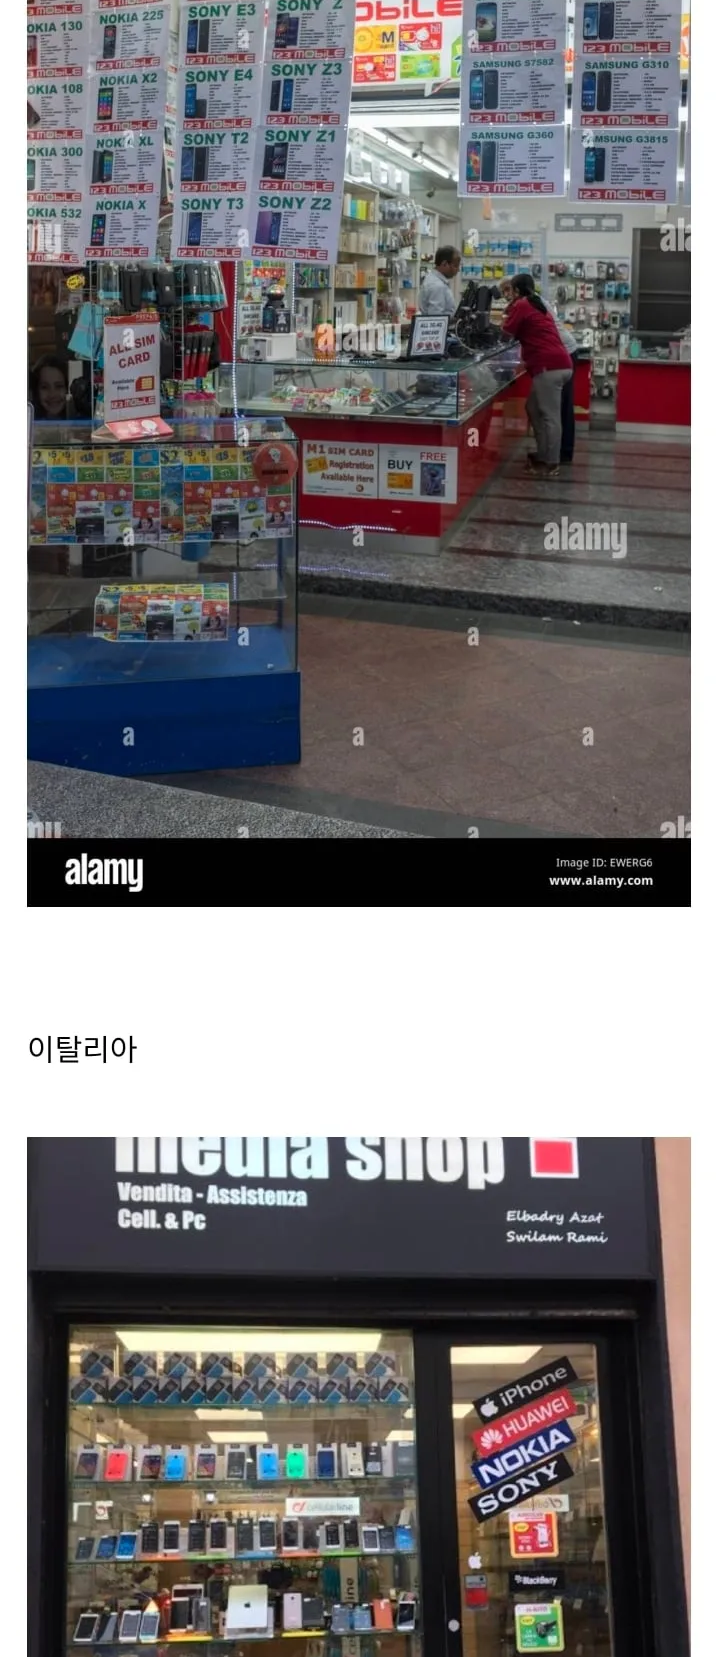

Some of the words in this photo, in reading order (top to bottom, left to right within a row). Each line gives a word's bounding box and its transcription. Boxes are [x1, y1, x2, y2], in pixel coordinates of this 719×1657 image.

[118, 352, 150, 369] CARD
[387, 459, 413, 470] BUY
[117, 1182, 193, 1204] Vendita
[206, 1185, 308, 1206] Assistenza
[499, 1366, 568, 1407] iPhone
[502, 1395, 569, 1438] HUAWEI
[479, 1427, 571, 1484] NOKIA
[477, 1460, 559, 1516] SONY
